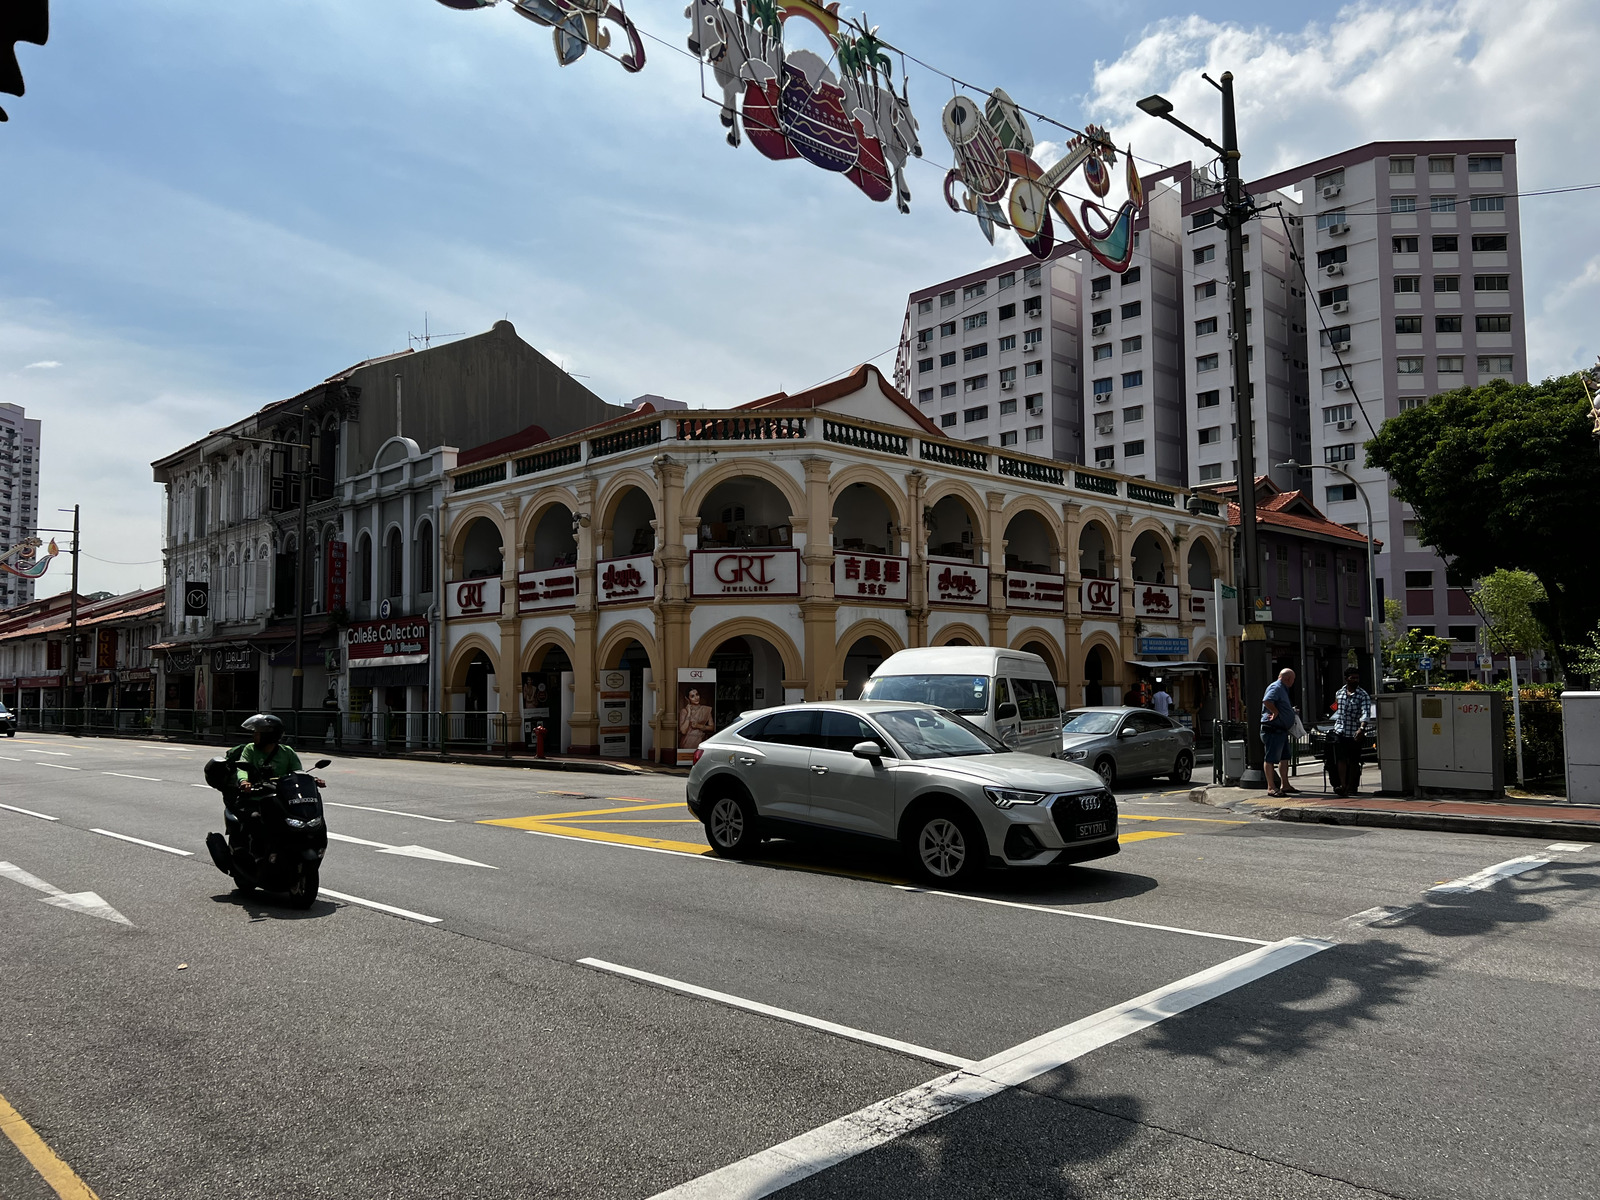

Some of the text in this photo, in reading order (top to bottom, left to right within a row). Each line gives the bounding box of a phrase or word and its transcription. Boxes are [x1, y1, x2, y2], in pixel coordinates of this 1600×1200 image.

[714, 554, 776, 585] GRT
[457, 581, 487, 608] GRT
[721, 585, 769, 593] JEWELLERS
[1087, 581, 1116, 606] GRT
[347, 622, 425, 645] College Collecton
